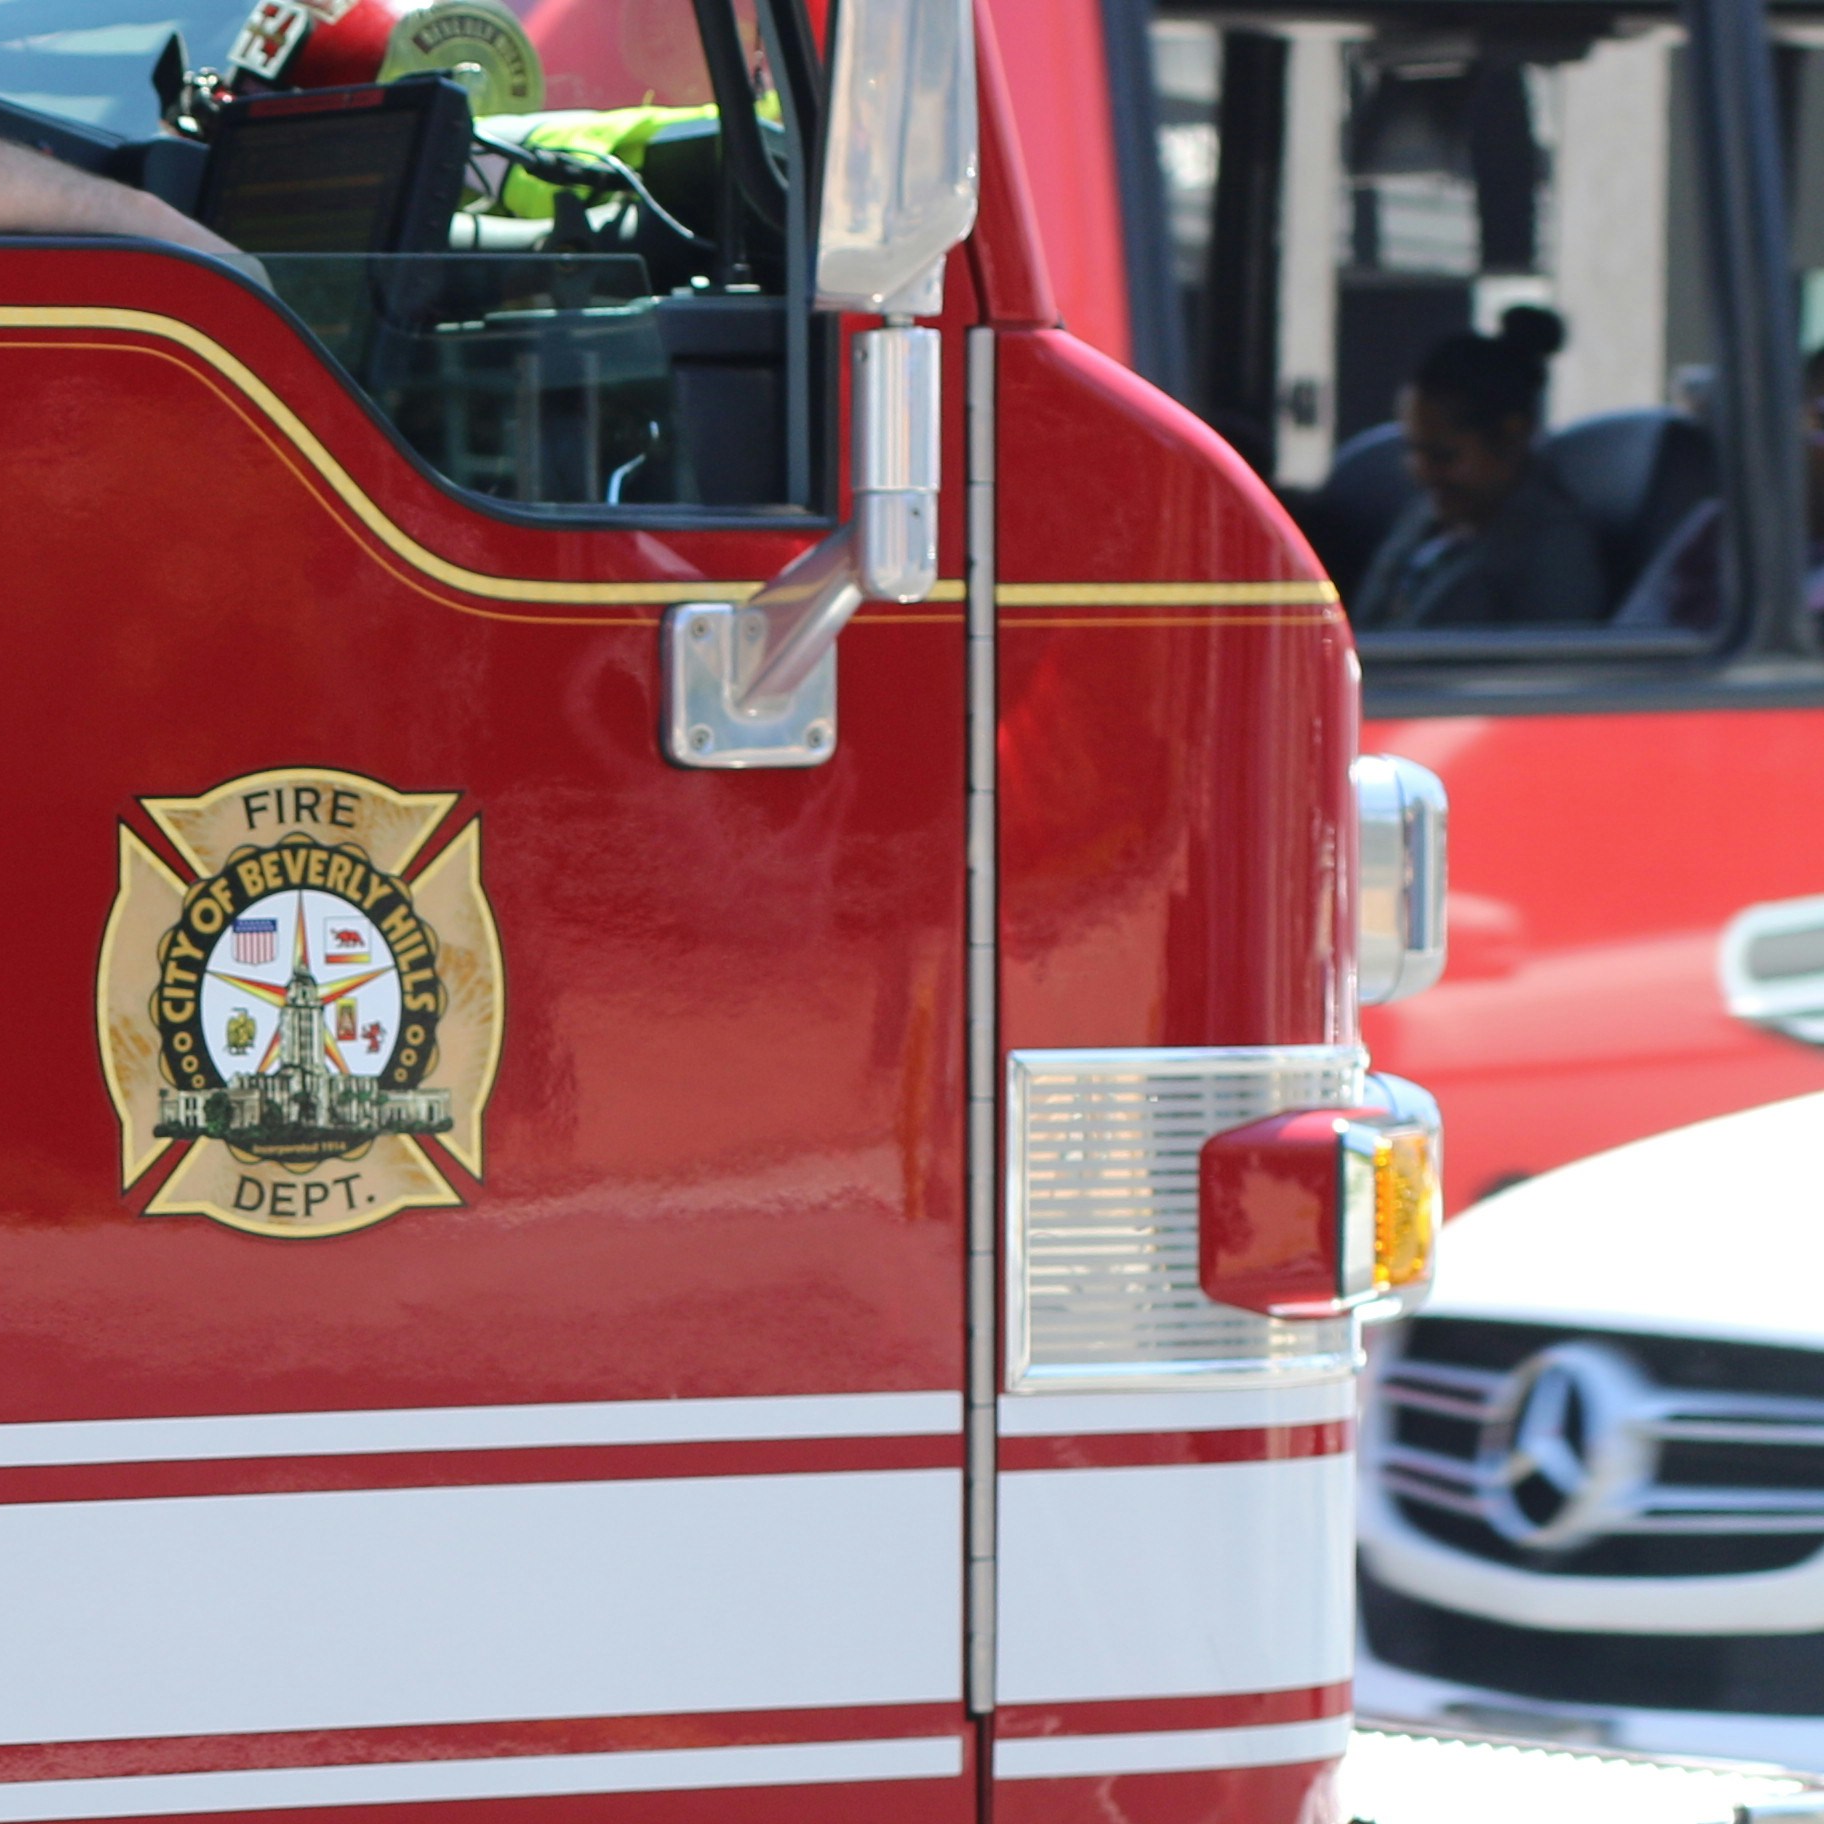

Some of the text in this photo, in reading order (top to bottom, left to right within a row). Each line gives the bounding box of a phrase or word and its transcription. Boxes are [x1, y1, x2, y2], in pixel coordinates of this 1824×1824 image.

[242, 787, 362, 830] FIRE
[163, 848, 436, 1024] CITY OF BEVERLY HILLS
[233, 1174, 375, 1217] DEPT.
